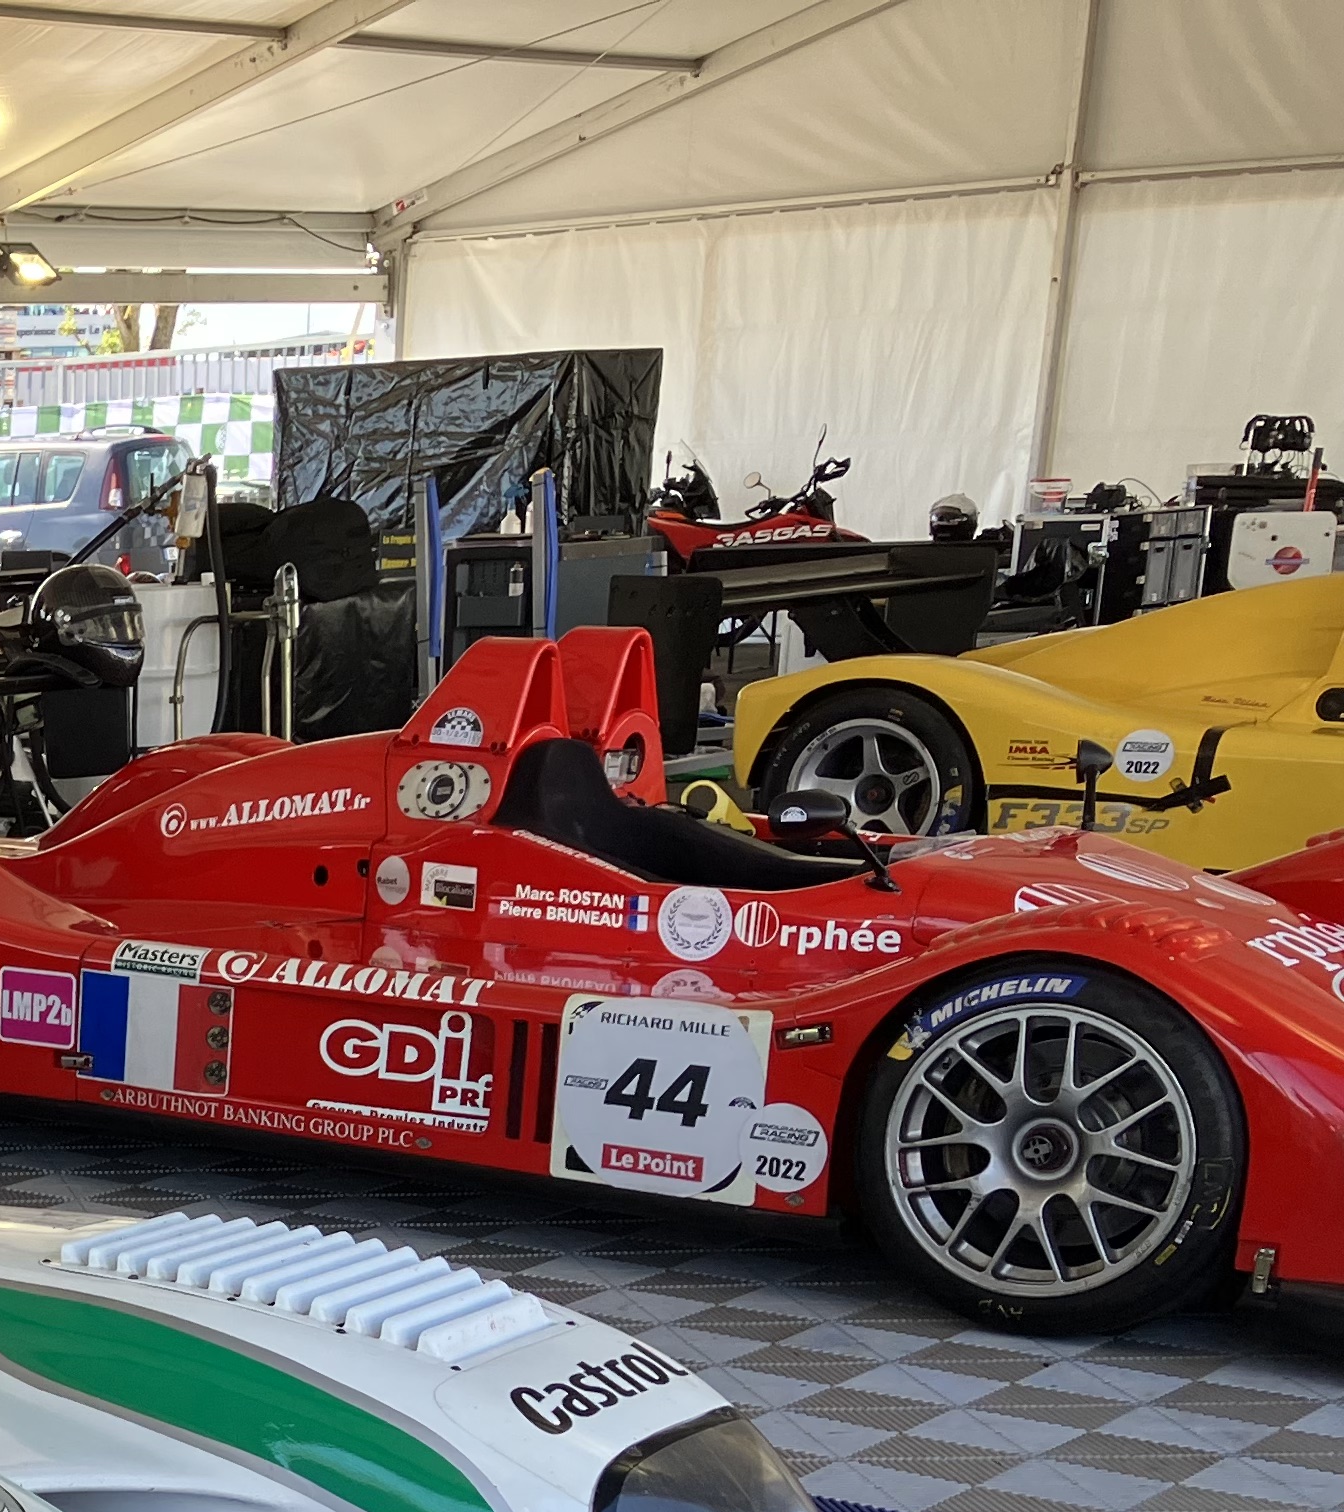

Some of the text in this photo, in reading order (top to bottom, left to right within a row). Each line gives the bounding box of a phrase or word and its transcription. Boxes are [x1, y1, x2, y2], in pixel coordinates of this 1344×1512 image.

[1125, 760, 1160, 774] 2022
[515, 884, 624, 909] Marc ROSTAN
[499, 900, 623, 928] Pierre BRUNEAU
[119, 942, 201, 968] Masters
[267, 957, 495, 1006] ALLOMAT
[1, 988, 72, 1027] LMP2b
[930, 977, 1073, 1029] MICHELIN
[600, 1011, 732, 1038] RICHARD MILLE
[603, 1057, 712, 1128] 44
[113, 1088, 414, 1148] ARBUTHNOT BANKING GROUP PLC
[759, 1129, 809, 1142] RACING
[610, 1148, 696, 1178] Le Point
[755, 1154, 807, 1182] 2022
[510, 1341, 690, 1435] Castrol
